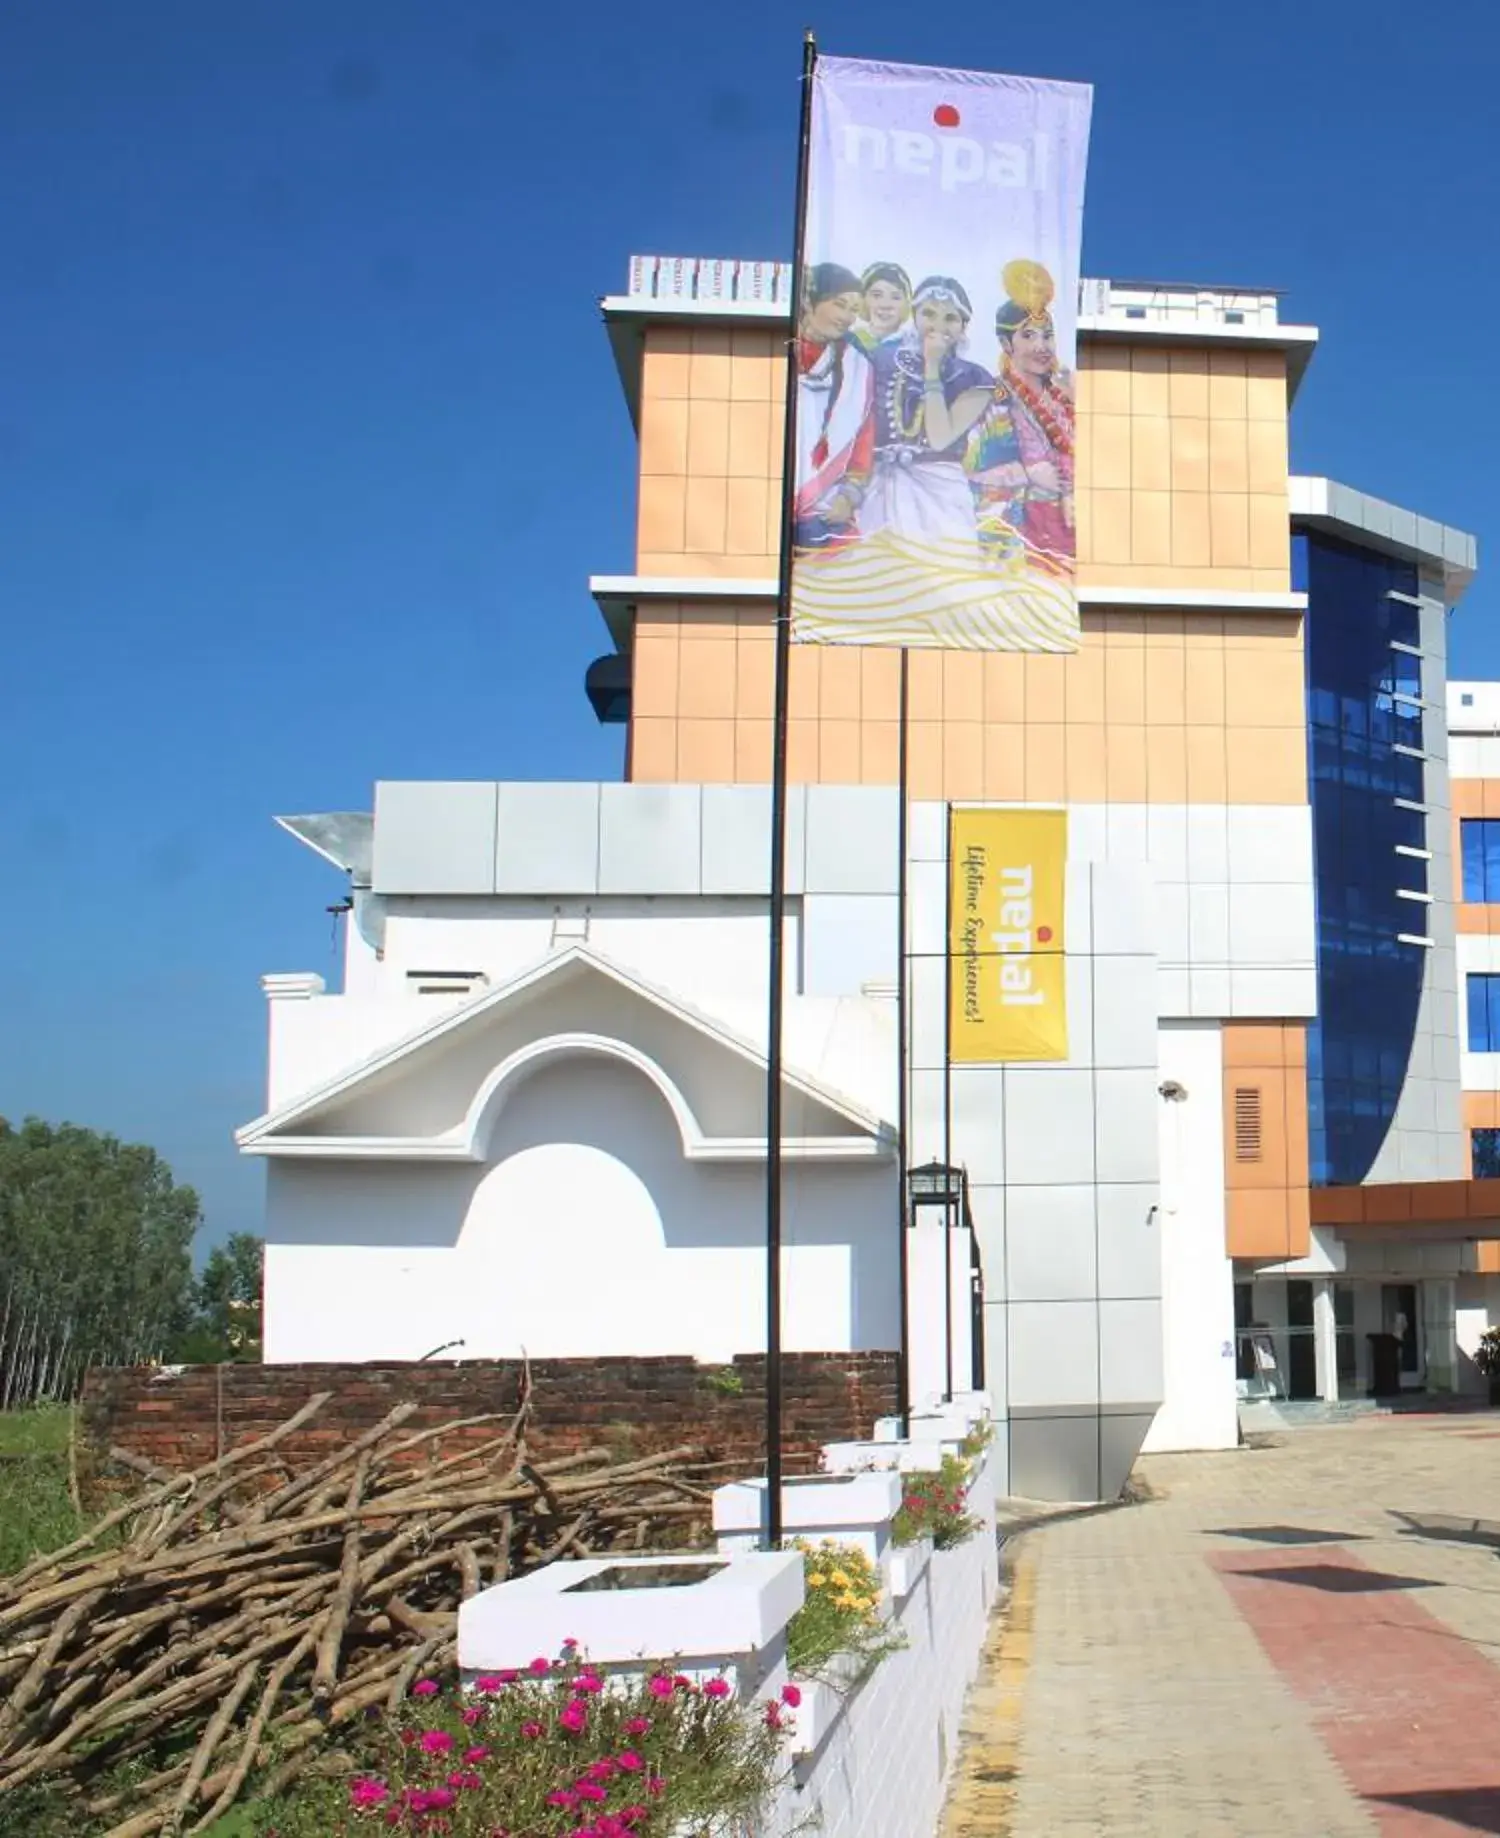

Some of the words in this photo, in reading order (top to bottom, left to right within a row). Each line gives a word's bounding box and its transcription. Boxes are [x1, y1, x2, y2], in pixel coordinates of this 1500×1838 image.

[843, 124, 1050, 192] nepal
[960, 846, 985, 911] Lifetime
[991, 864, 1044, 1006] nepal
